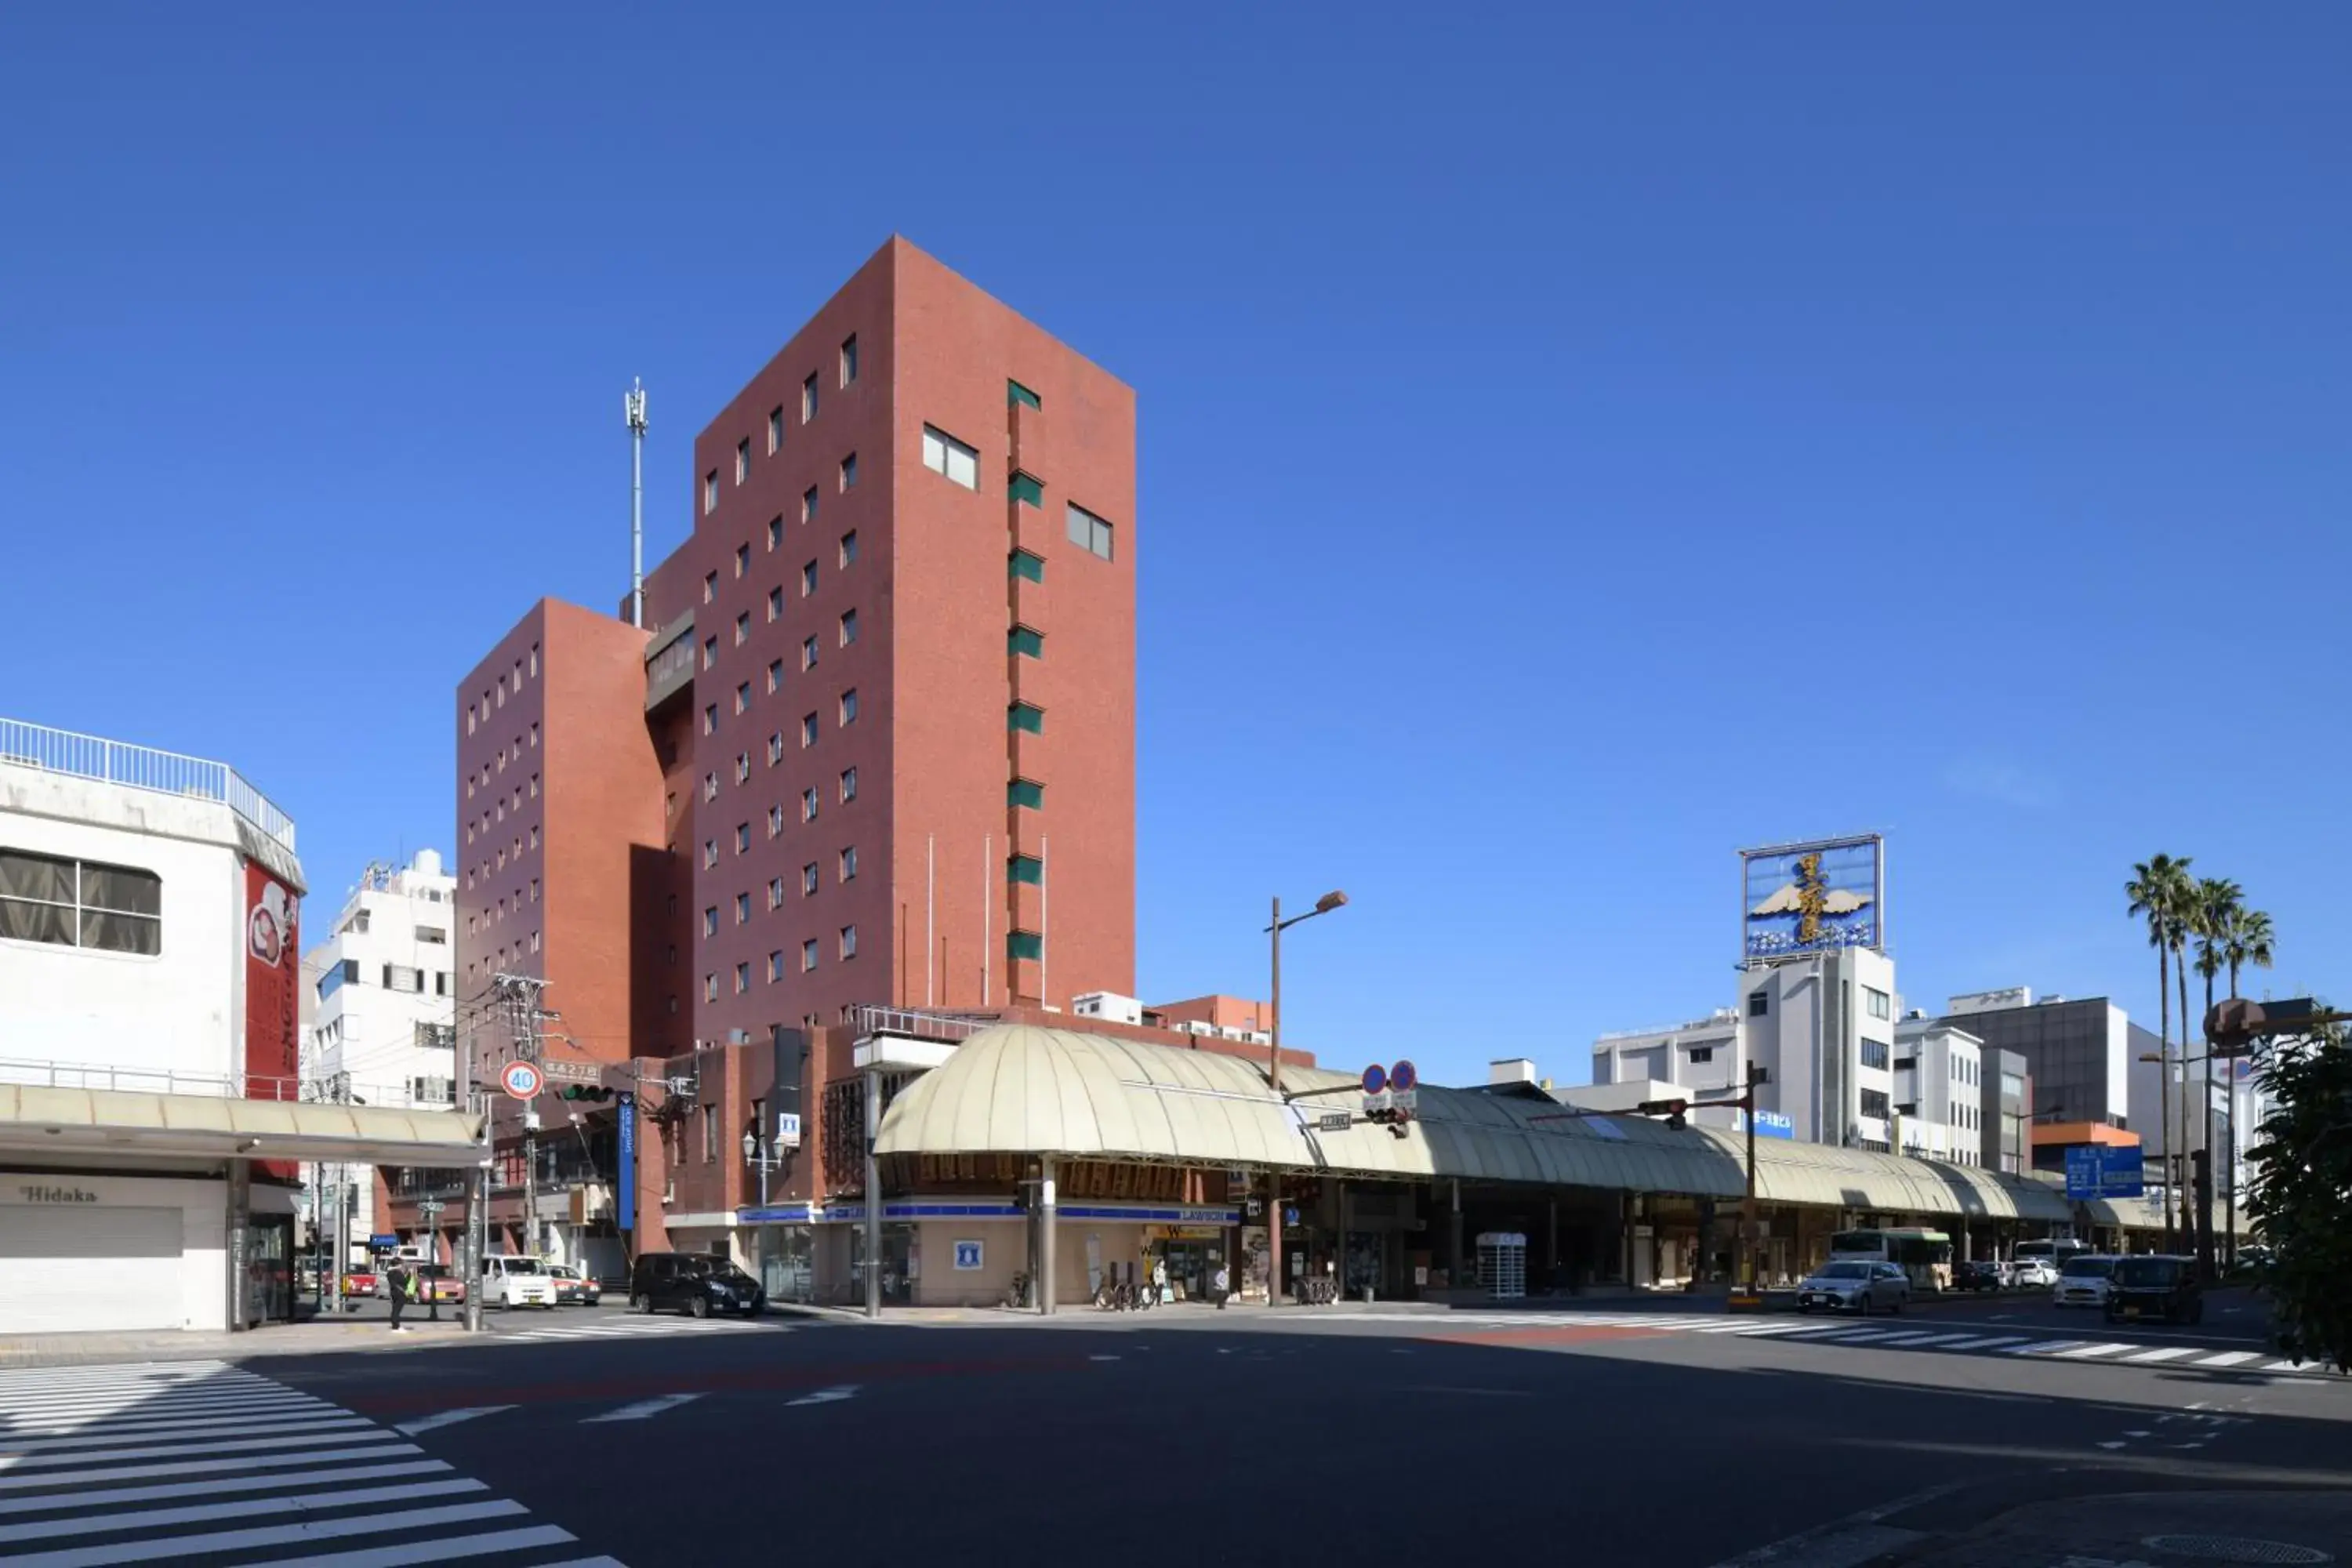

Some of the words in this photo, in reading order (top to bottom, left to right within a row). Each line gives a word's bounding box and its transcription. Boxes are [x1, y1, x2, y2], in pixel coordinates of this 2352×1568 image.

[512, 1071, 533, 1089] 40
[27, 1186, 98, 1203] Hidaka
[1182, 1210, 1224, 1220] LAWSON
